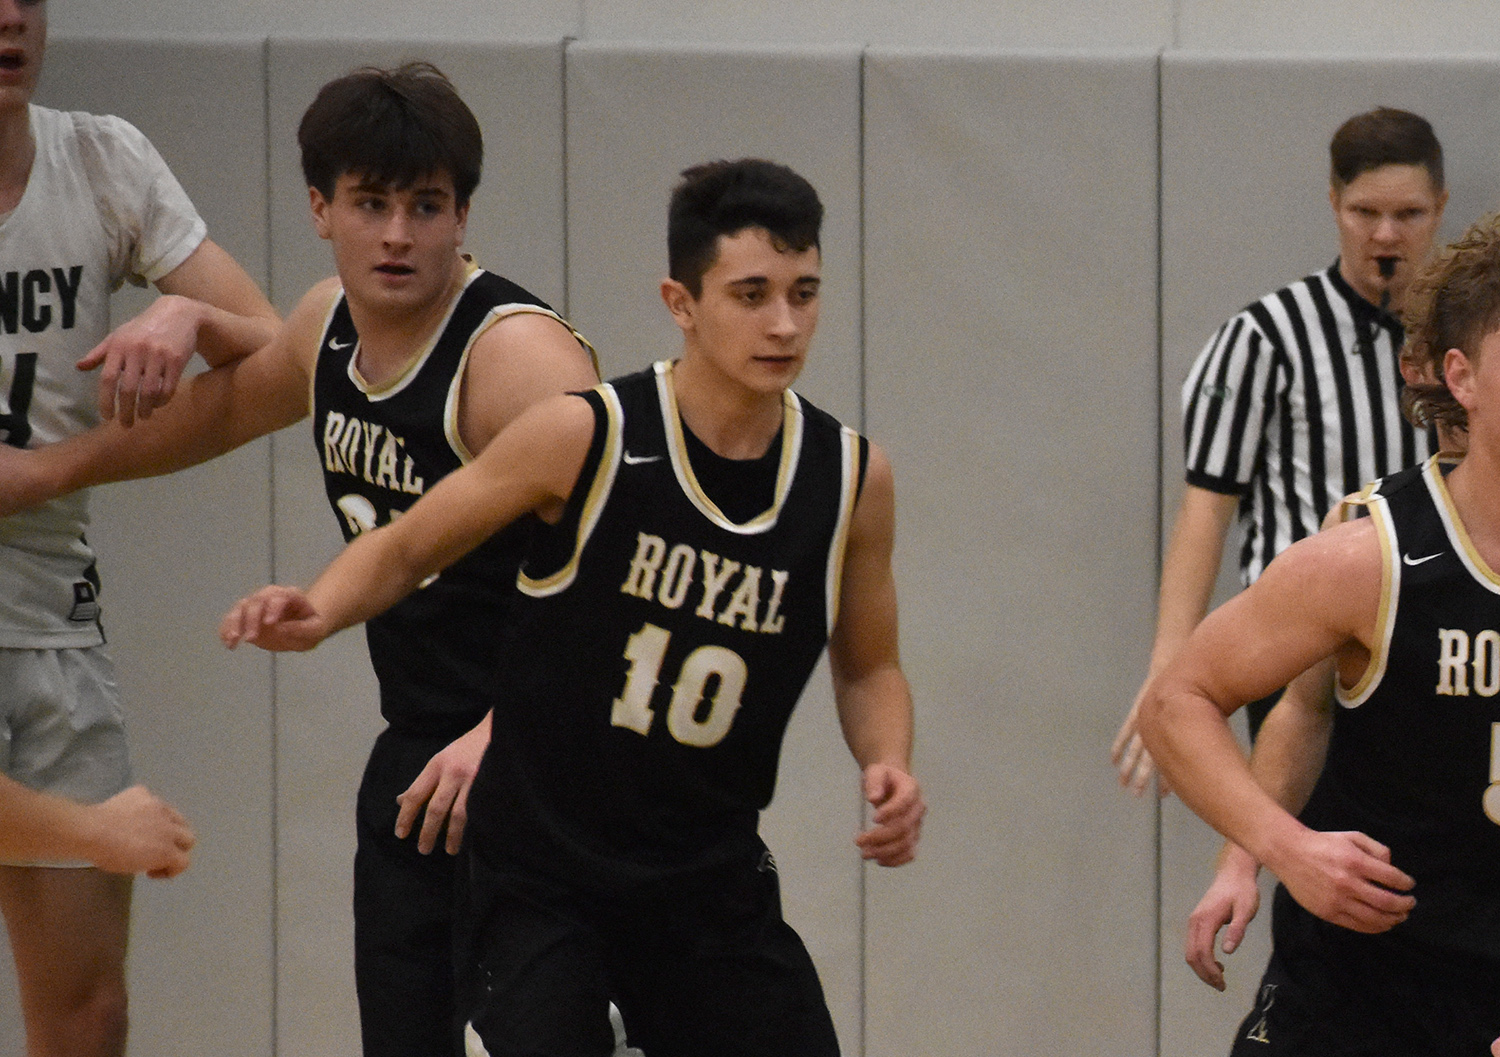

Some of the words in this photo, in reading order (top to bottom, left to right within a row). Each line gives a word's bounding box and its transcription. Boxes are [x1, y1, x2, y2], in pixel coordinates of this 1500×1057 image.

[324, 410, 424, 495] ROYAL
[620, 531, 789, 634] ROYAL
[610, 622, 748, 748] 10
